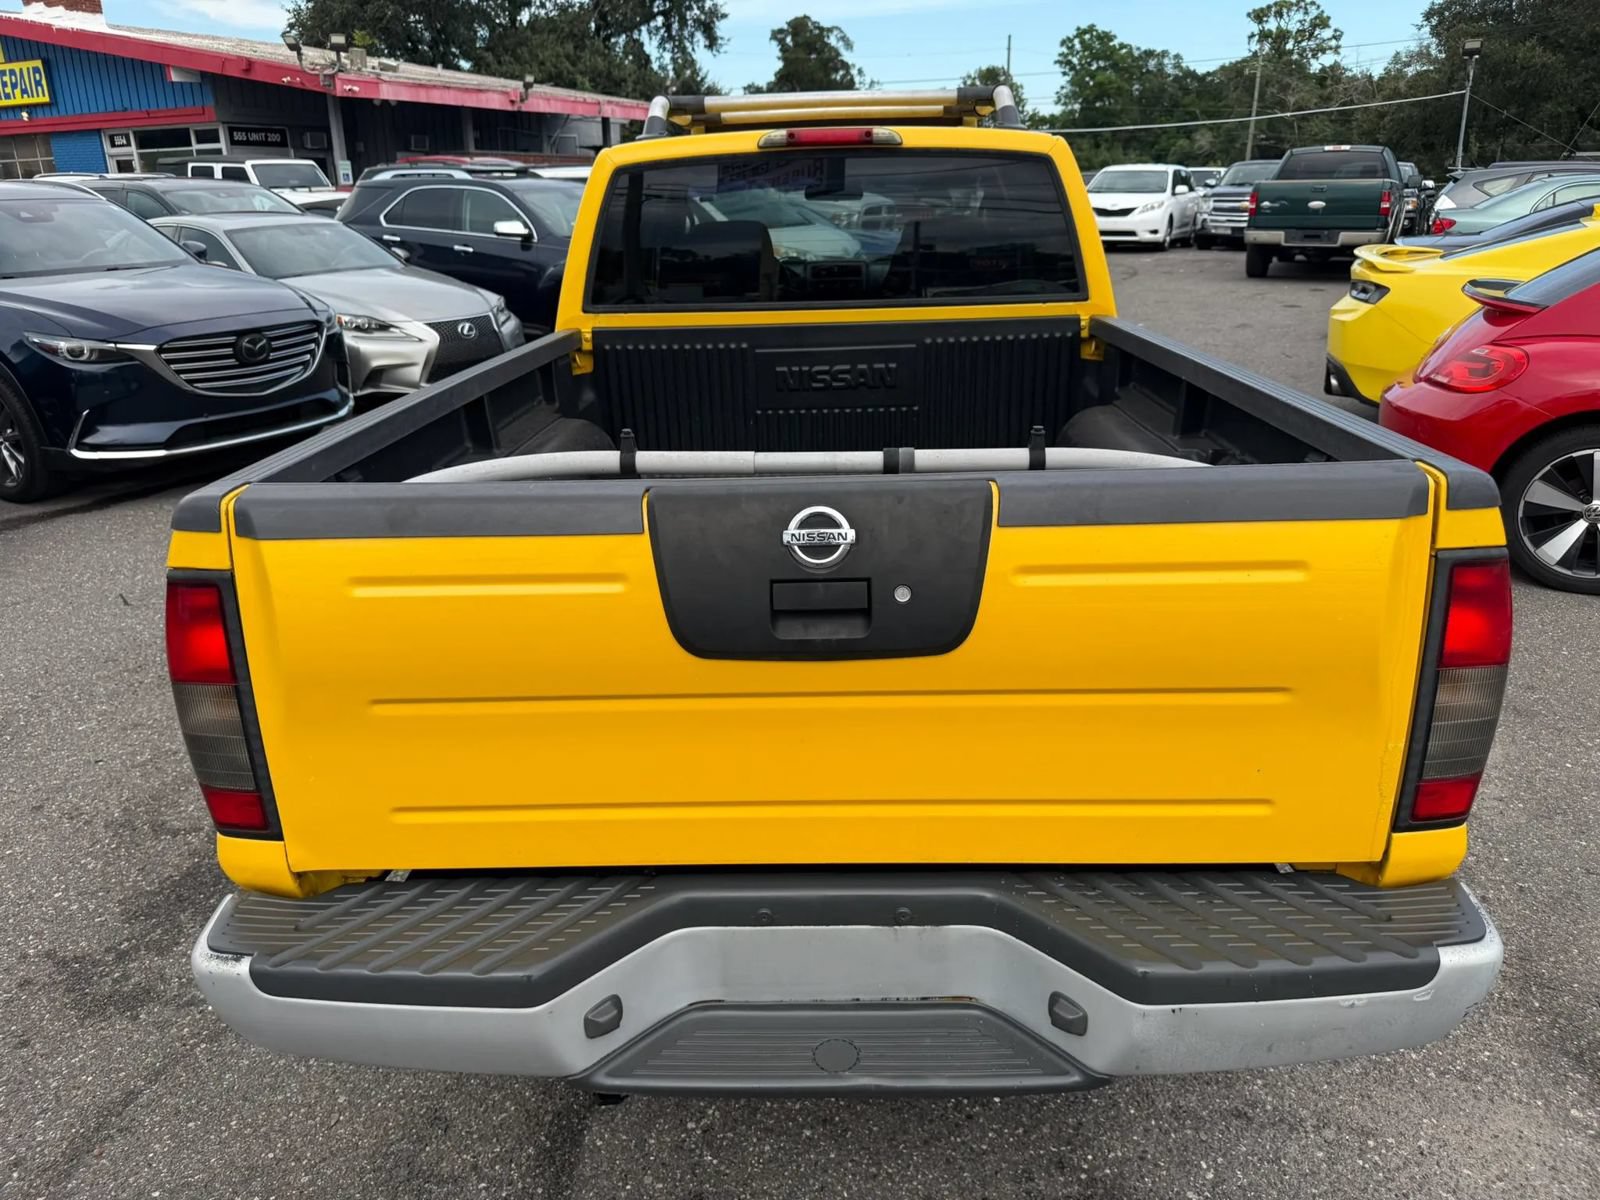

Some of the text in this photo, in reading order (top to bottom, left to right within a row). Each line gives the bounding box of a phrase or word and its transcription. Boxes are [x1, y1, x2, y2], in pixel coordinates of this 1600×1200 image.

[0, 66, 46, 100] EPAIR
[233, 131, 281, 142] 555 UNIT 200
[775, 363, 897, 391] NISSAN
[790, 532, 848, 542] NISSAN
